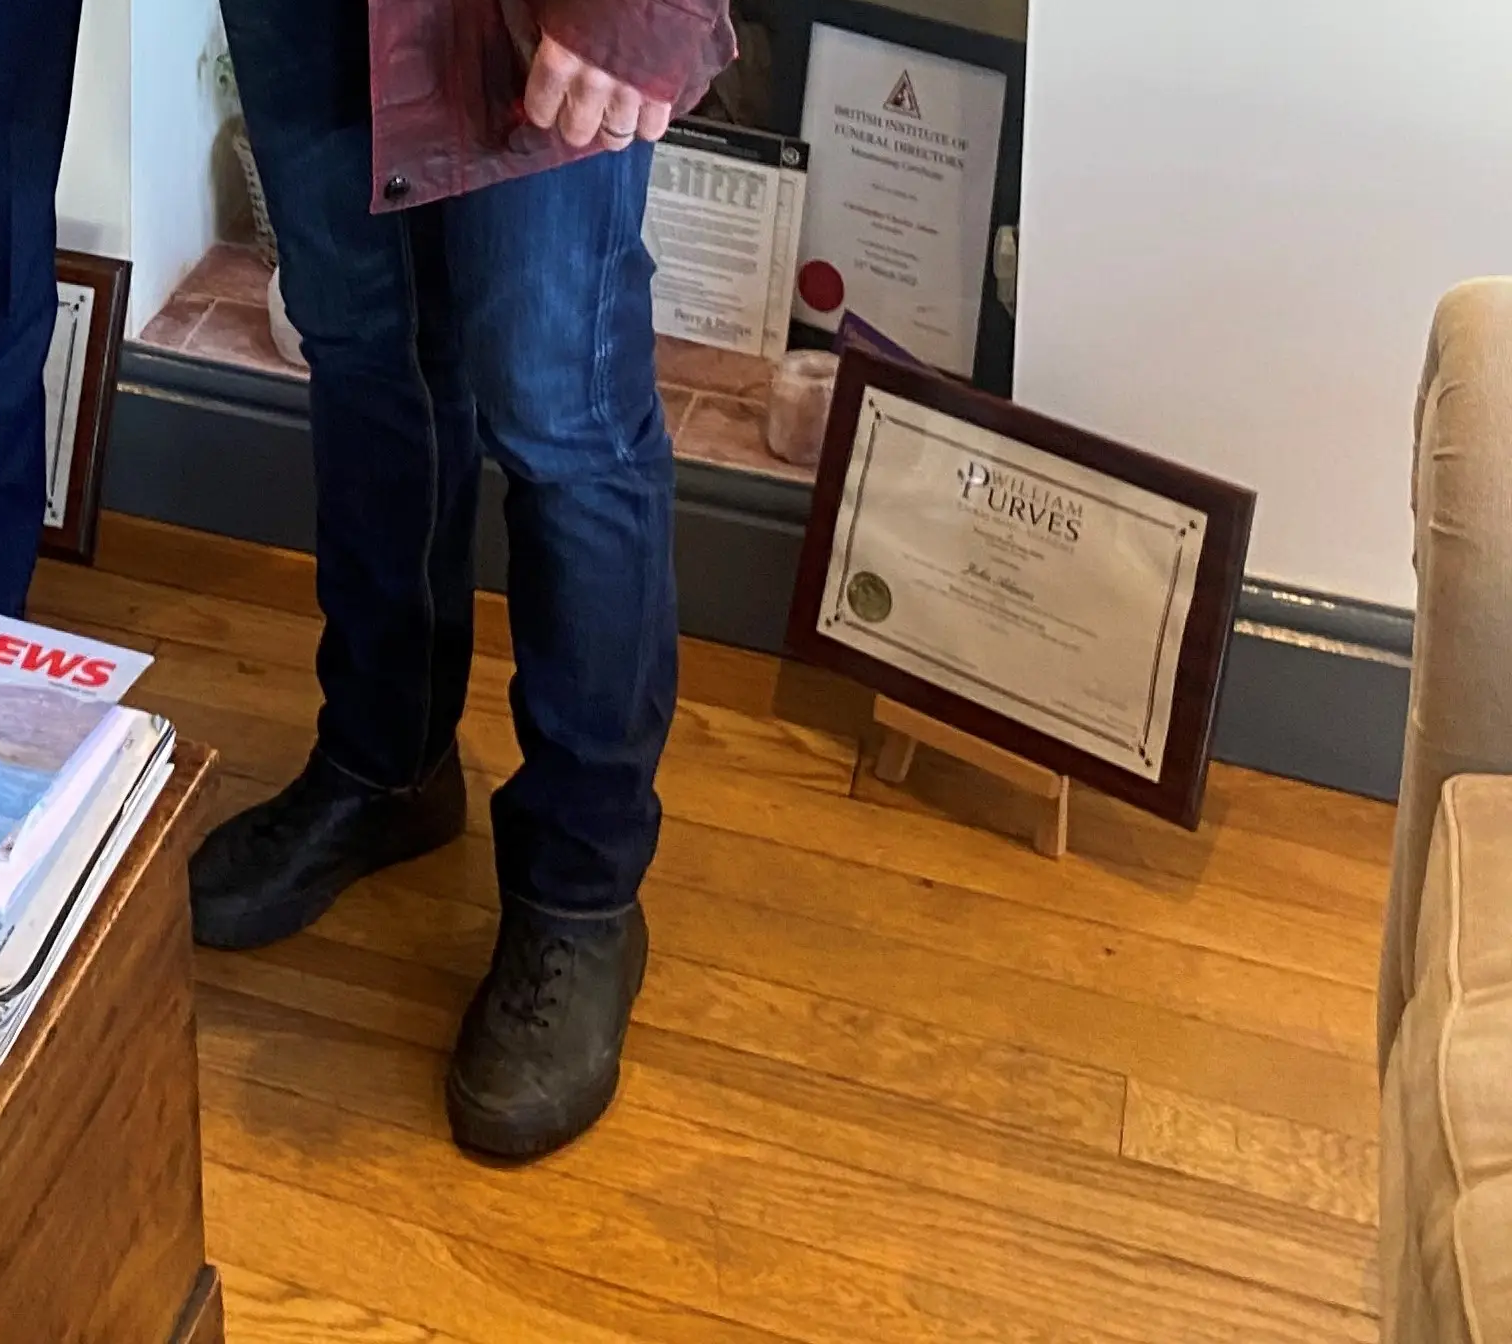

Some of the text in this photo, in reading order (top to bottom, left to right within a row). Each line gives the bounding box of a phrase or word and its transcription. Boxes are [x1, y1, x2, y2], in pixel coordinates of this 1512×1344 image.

[833, 123, 889, 149] FUNERAL
[893, 140, 965, 169] DIRECTORS
[885, 118, 949, 147] INSTITUTE
[961, 461, 1083, 543] PURVES
[991, 469, 1084, 519] WILLIAM
